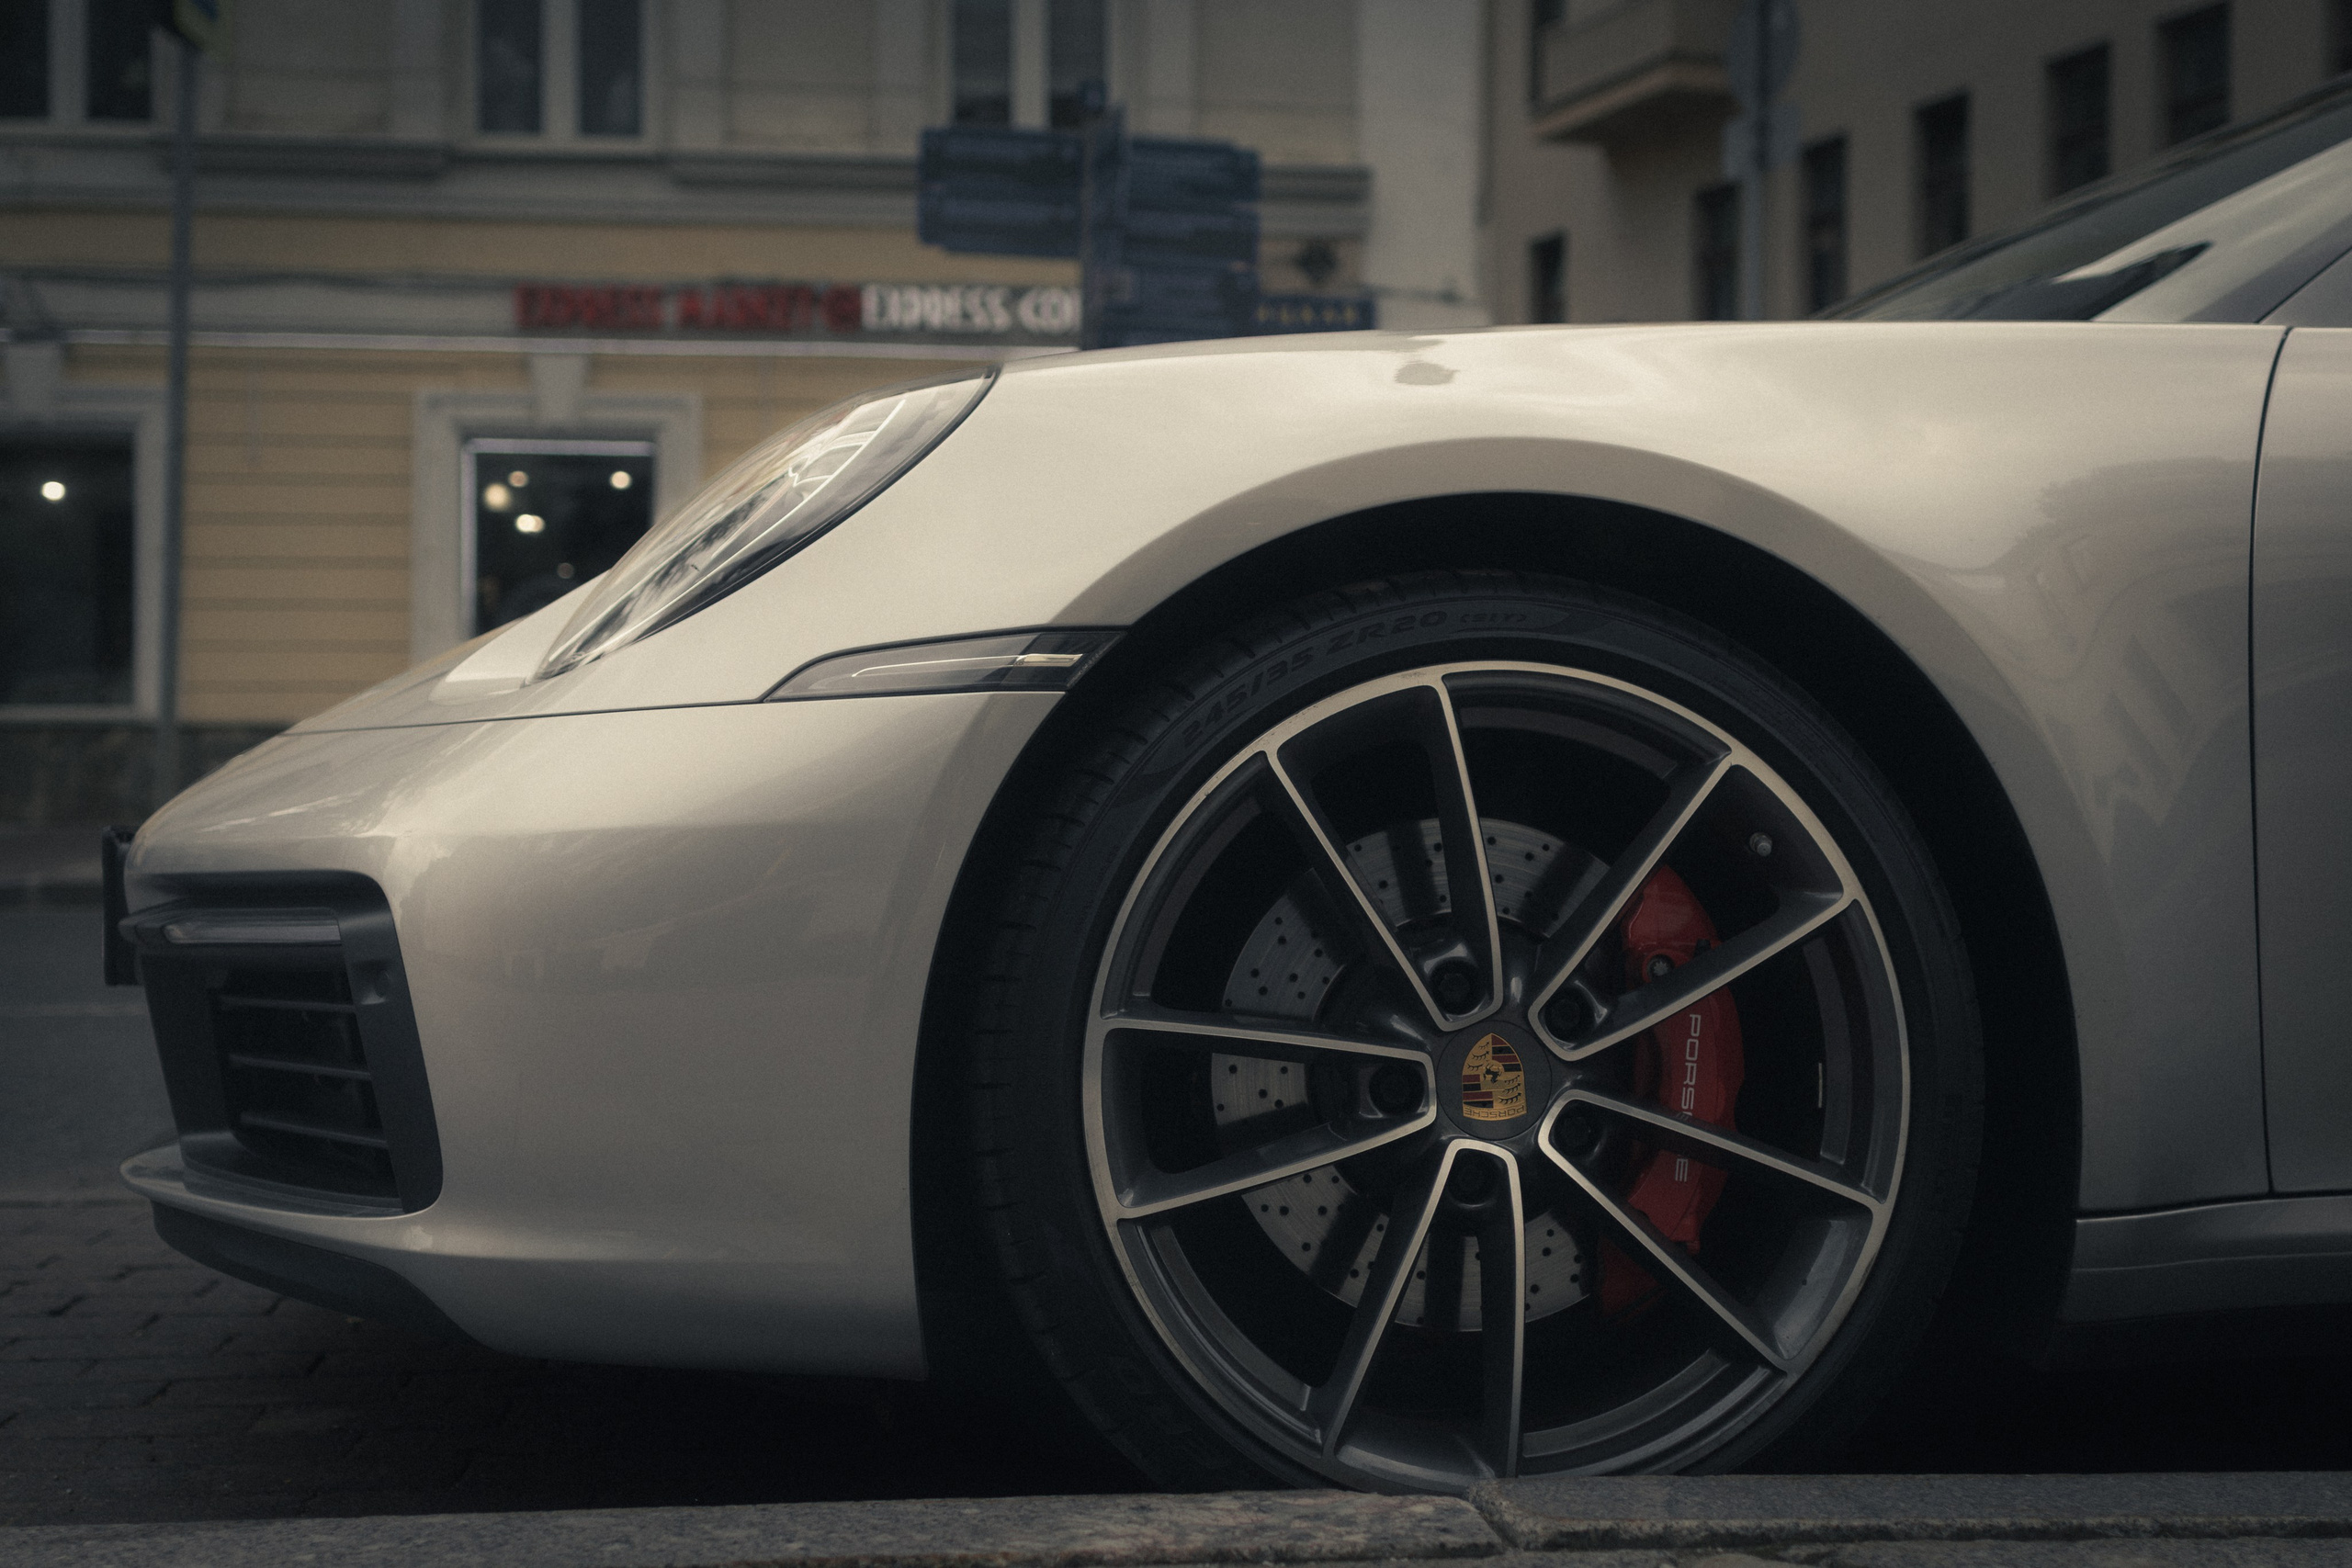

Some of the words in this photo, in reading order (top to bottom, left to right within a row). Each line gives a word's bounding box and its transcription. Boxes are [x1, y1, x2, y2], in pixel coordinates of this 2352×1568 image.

[1182, 648, 1315, 748] 245/35
[1464, 1104, 1525, 1119] PORSCHE
[1674, 1013, 1702, 1183] PORSE
